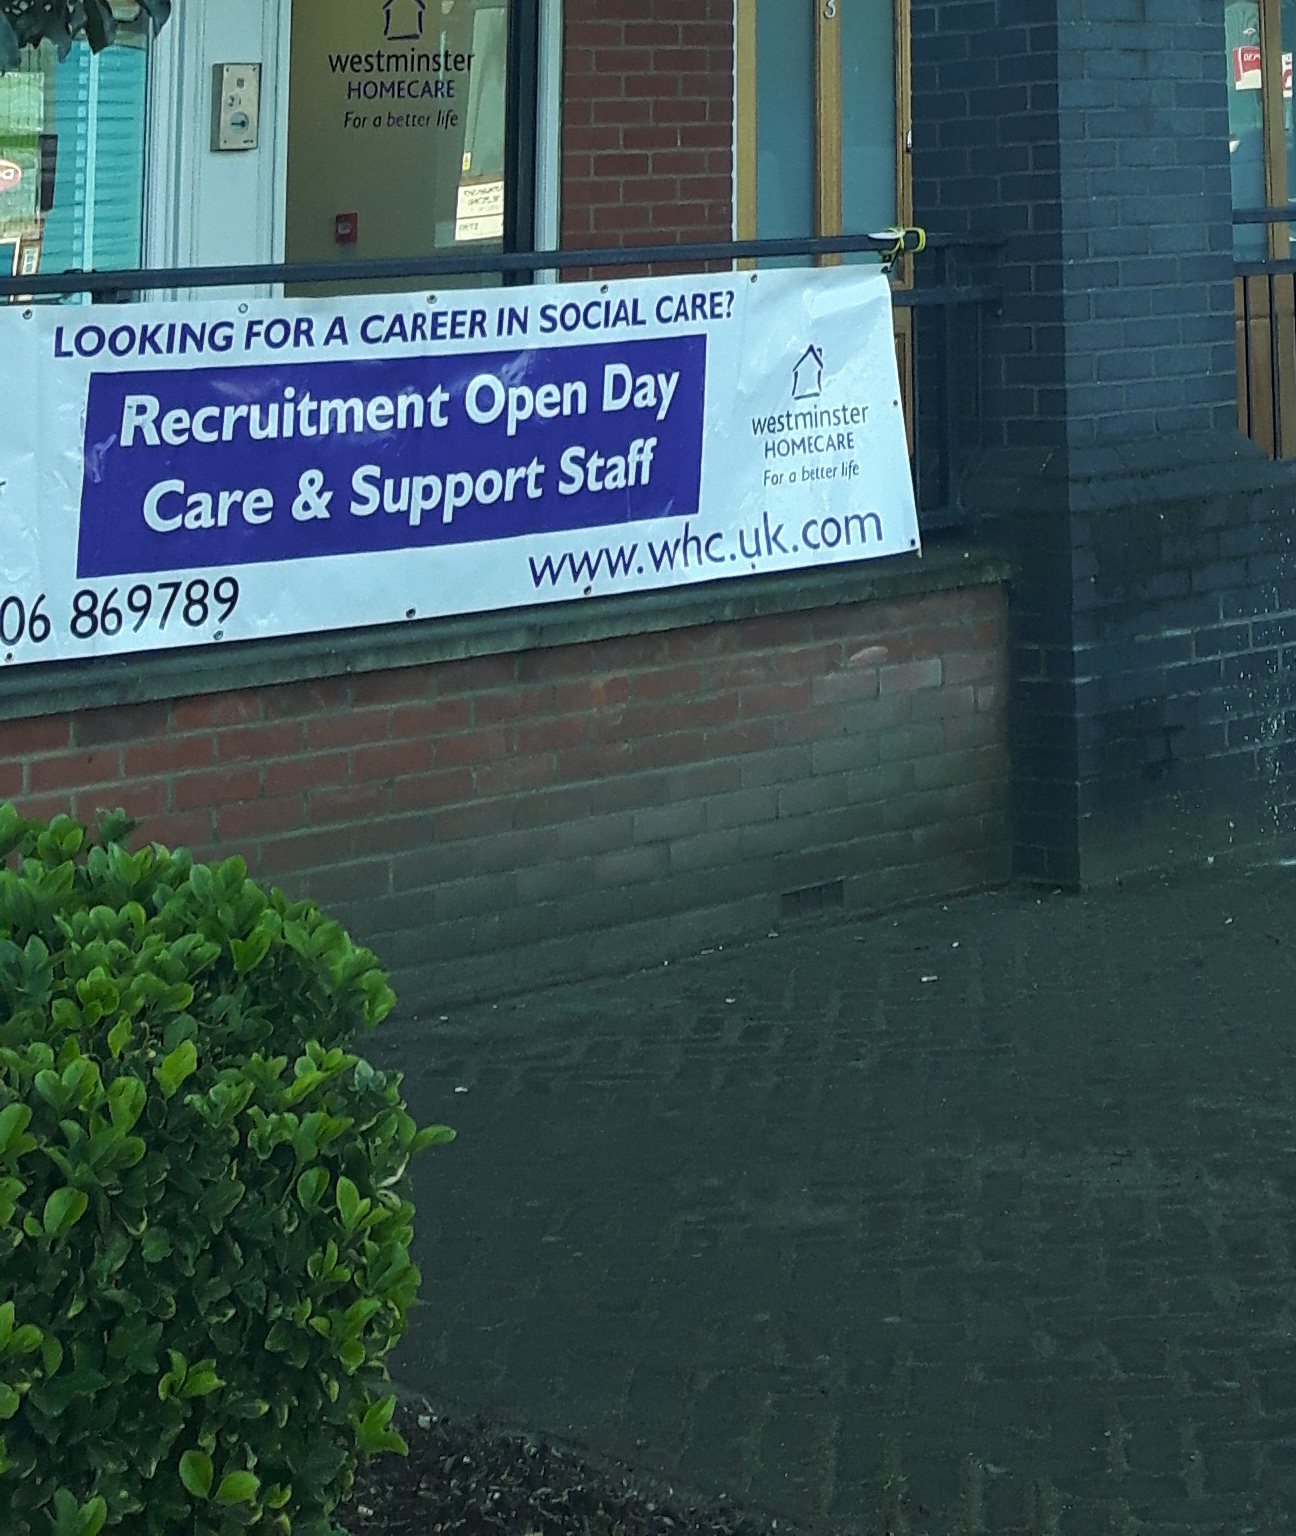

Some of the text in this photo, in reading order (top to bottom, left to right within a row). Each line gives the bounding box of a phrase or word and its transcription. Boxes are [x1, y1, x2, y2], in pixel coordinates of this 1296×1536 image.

[329, 47, 476, 73] westminster
[347, 79, 456, 99] HOMECARE
[344, 110, 459, 130] For a better life
[54, 290, 736, 358] LOOKING FOR A CAREER IN SOCIAL CARE?
[119, 362, 680, 448] Recruitment Open Day
[751, 404, 869, 436] westminster
[764, 431, 855, 460] HOMECARE
[142, 437, 658, 533] Care & Support Staff
[763, 459, 860, 486] For a better life
[529, 511, 883, 588] www.whc.uk.com
[70, 575, 240, 640] 869789
